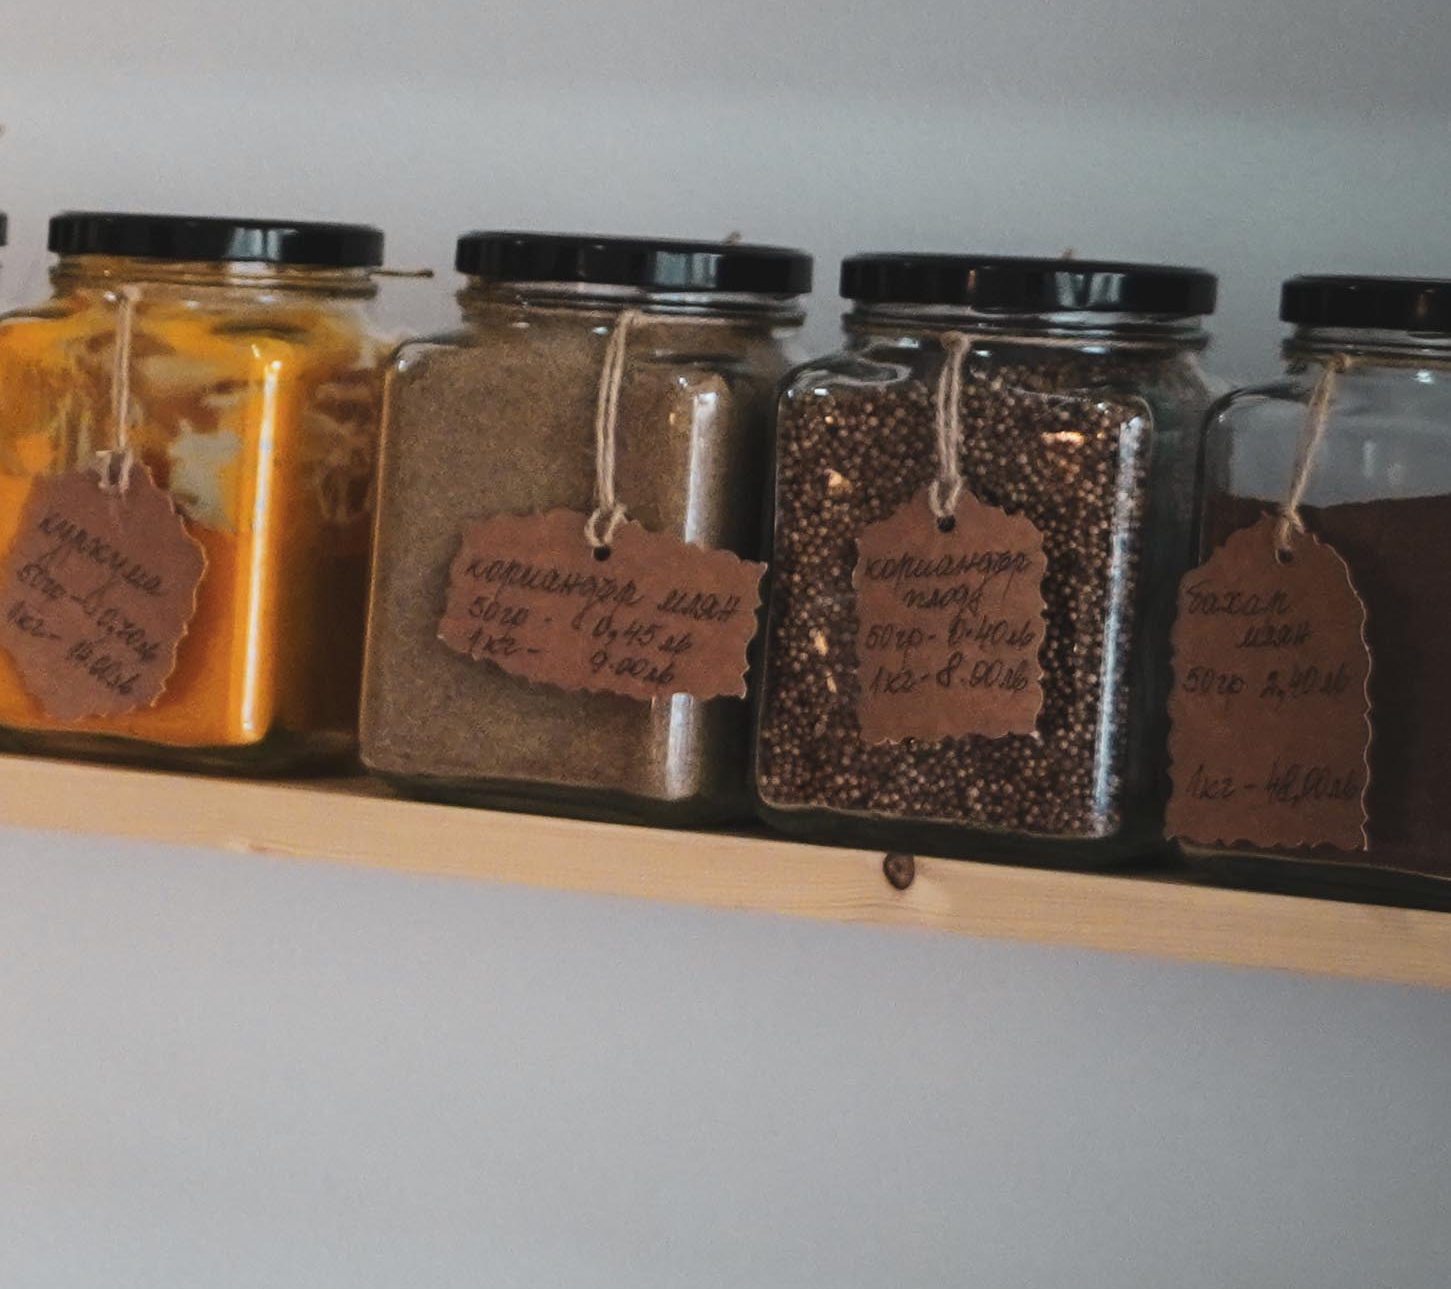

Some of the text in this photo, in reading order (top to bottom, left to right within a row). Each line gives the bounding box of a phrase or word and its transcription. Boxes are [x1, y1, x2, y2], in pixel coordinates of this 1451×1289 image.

[39, 513, 163, 597] куркума
[865, 551, 1032, 592] кориандър
[467, 557, 740, 622] кориандър млян
[1185, 579, 1291, 615] бахар
